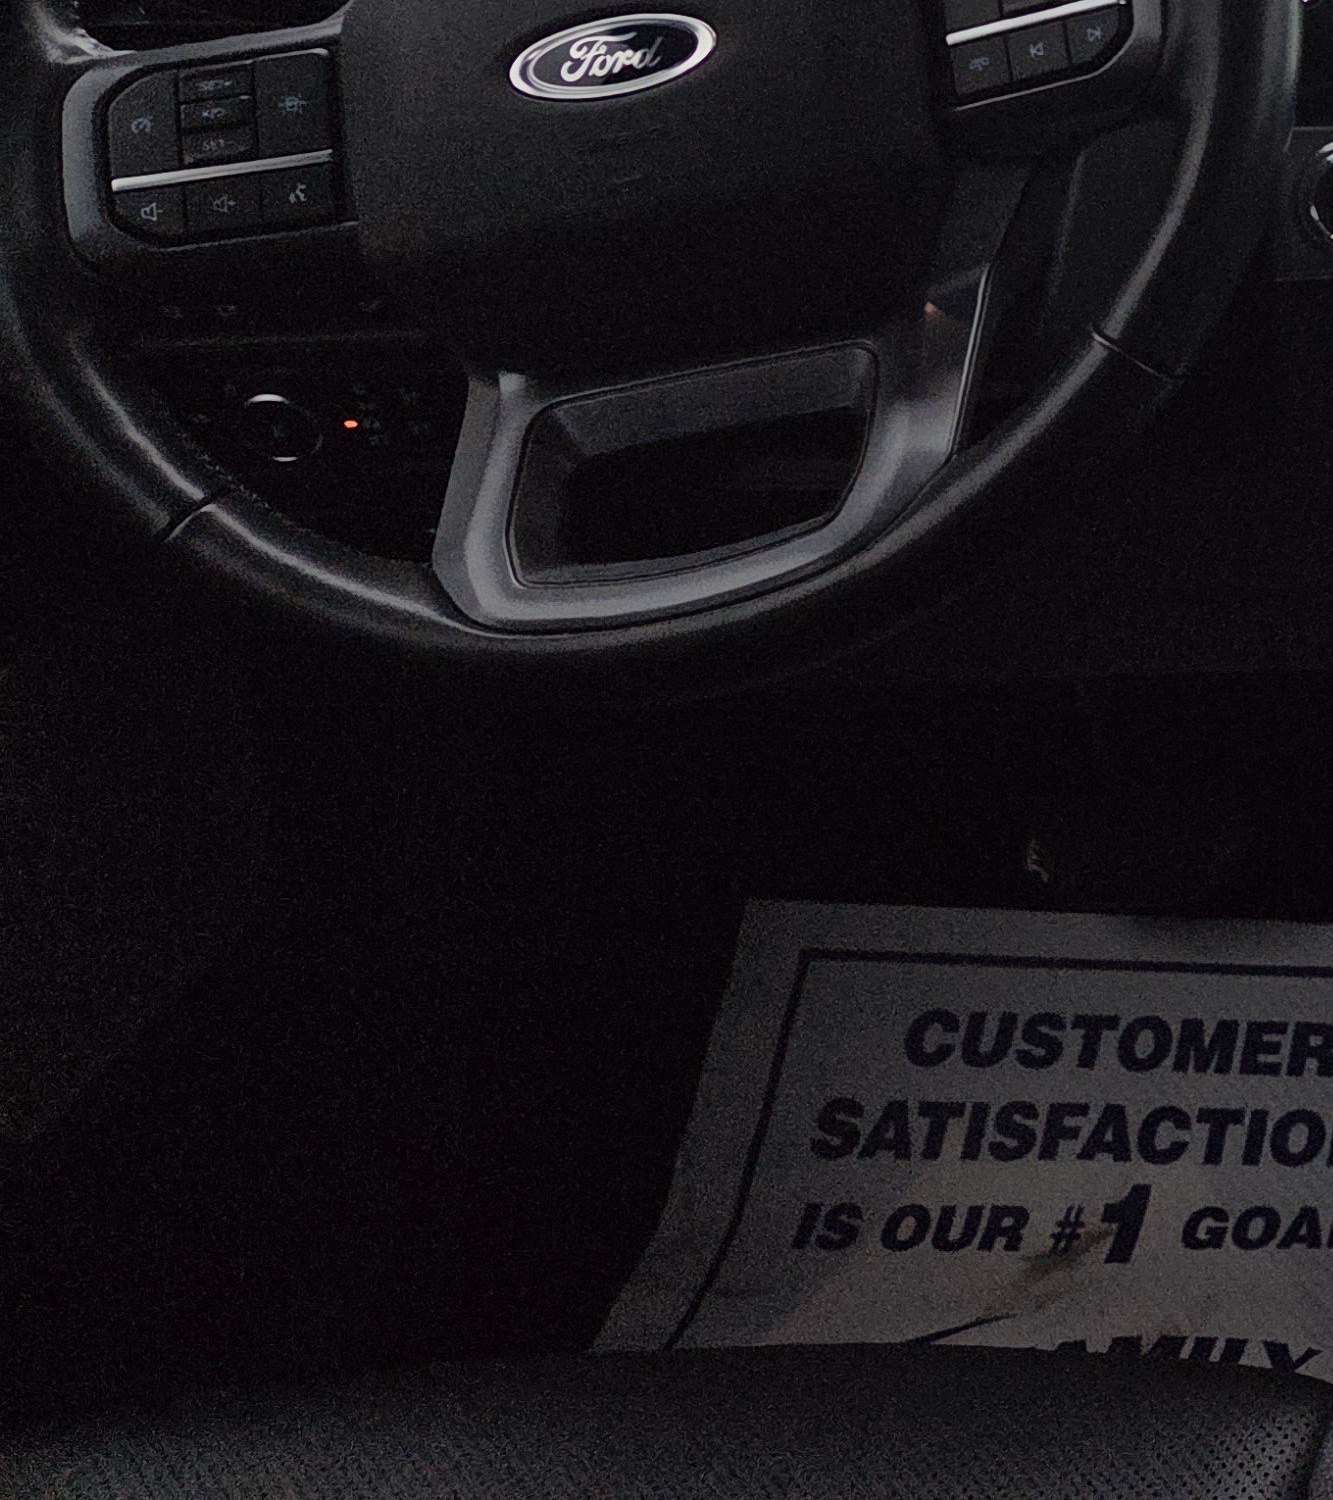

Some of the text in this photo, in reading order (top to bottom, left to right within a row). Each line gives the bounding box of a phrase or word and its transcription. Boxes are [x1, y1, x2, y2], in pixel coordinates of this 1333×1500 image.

[560, 31, 664, 73] Ford
[792, 1201, 863, 1252] IS
[881, 1202, 1030, 1254] OUR
[1049, 1182, 1154, 1265] #1
